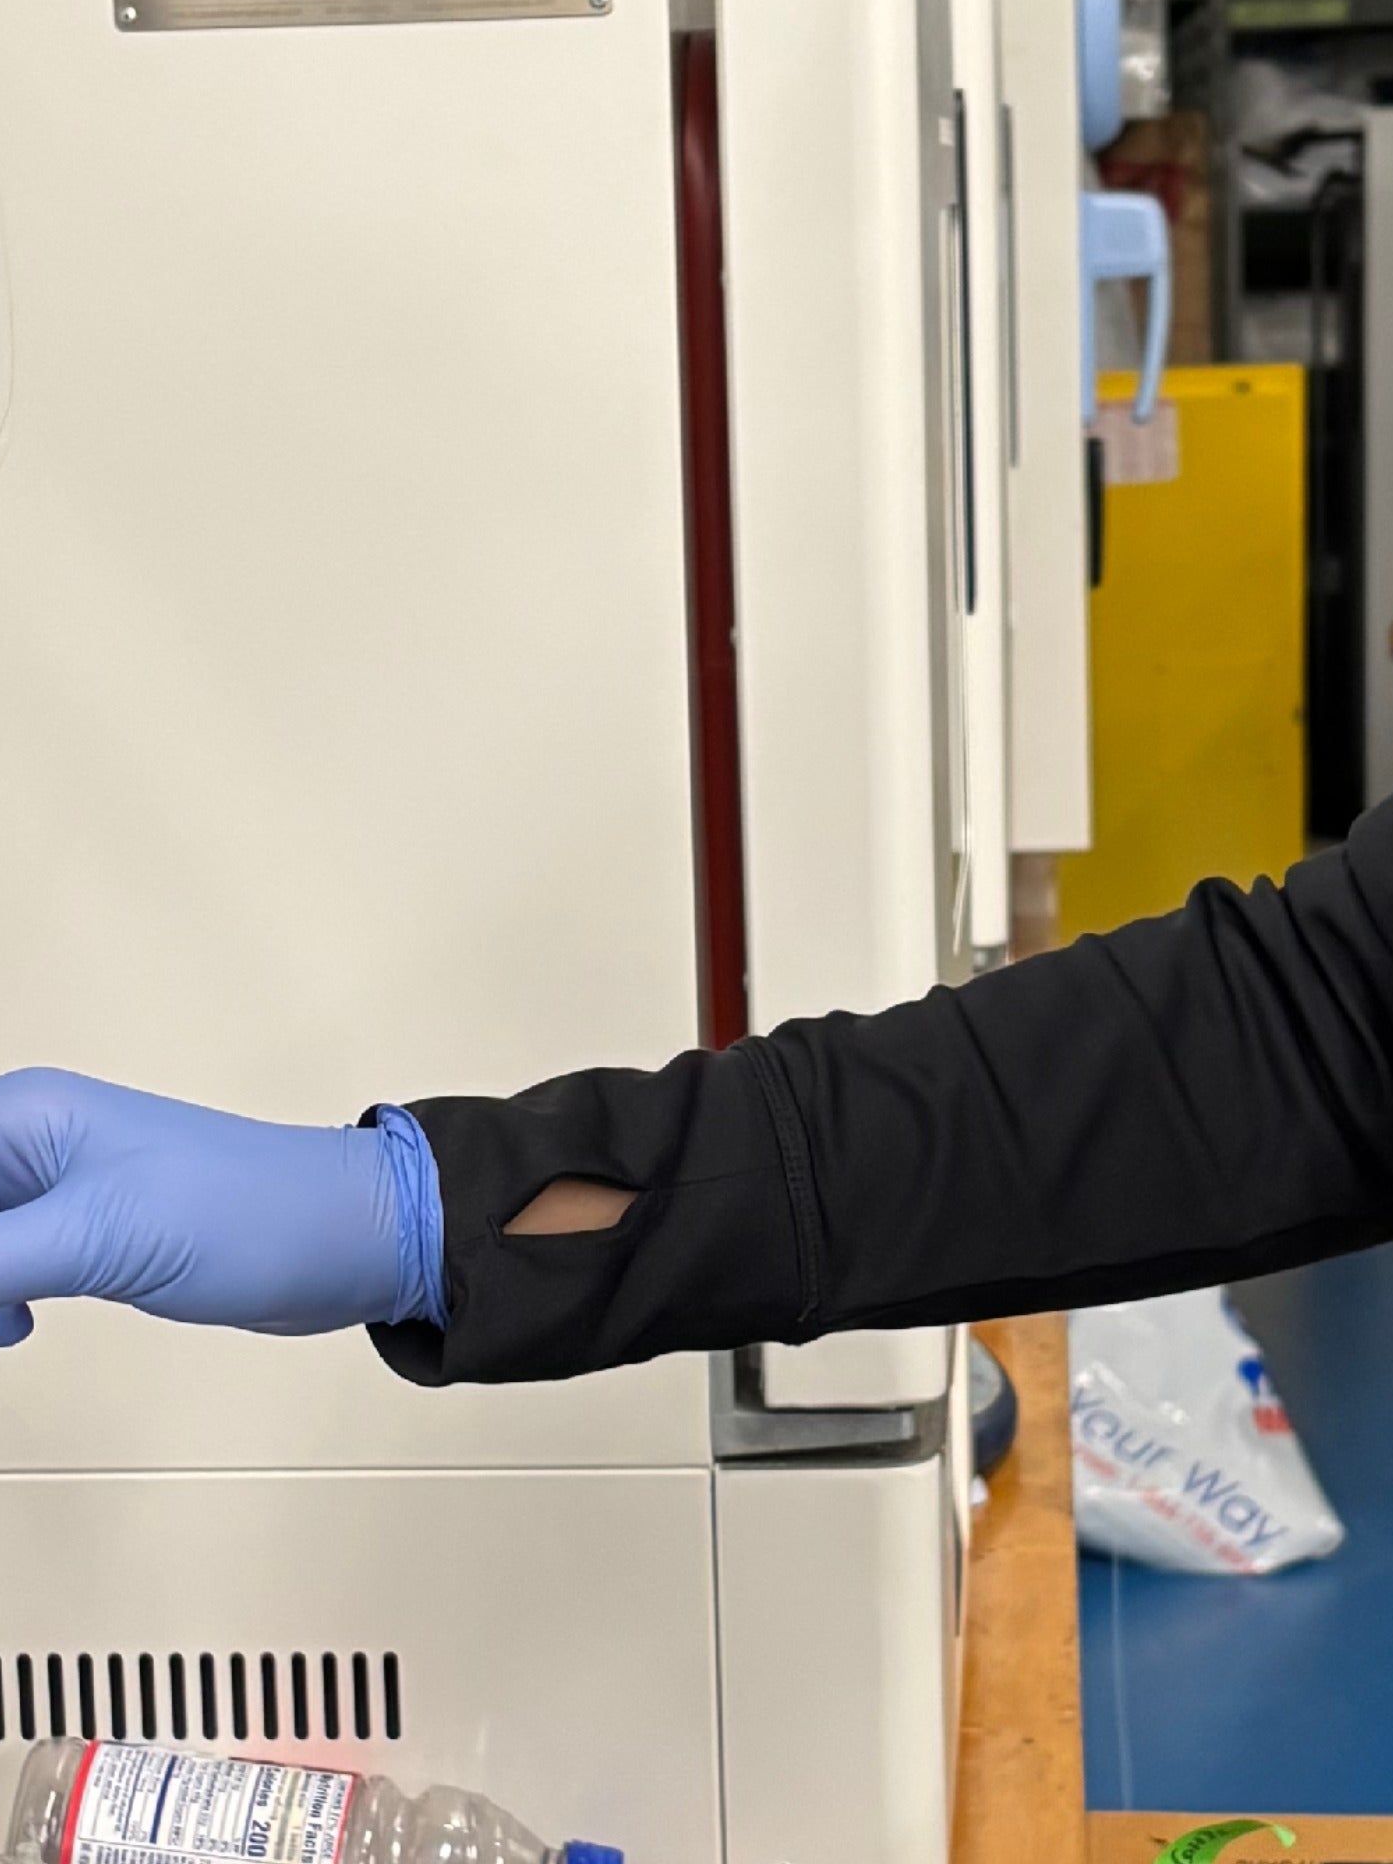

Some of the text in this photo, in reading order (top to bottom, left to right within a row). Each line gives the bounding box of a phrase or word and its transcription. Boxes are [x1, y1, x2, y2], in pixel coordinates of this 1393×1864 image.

[1183, 1460, 1289, 1547] way
[247, 1820, 271, 1858] 200
[301, 1821, 323, 1864] Facts
